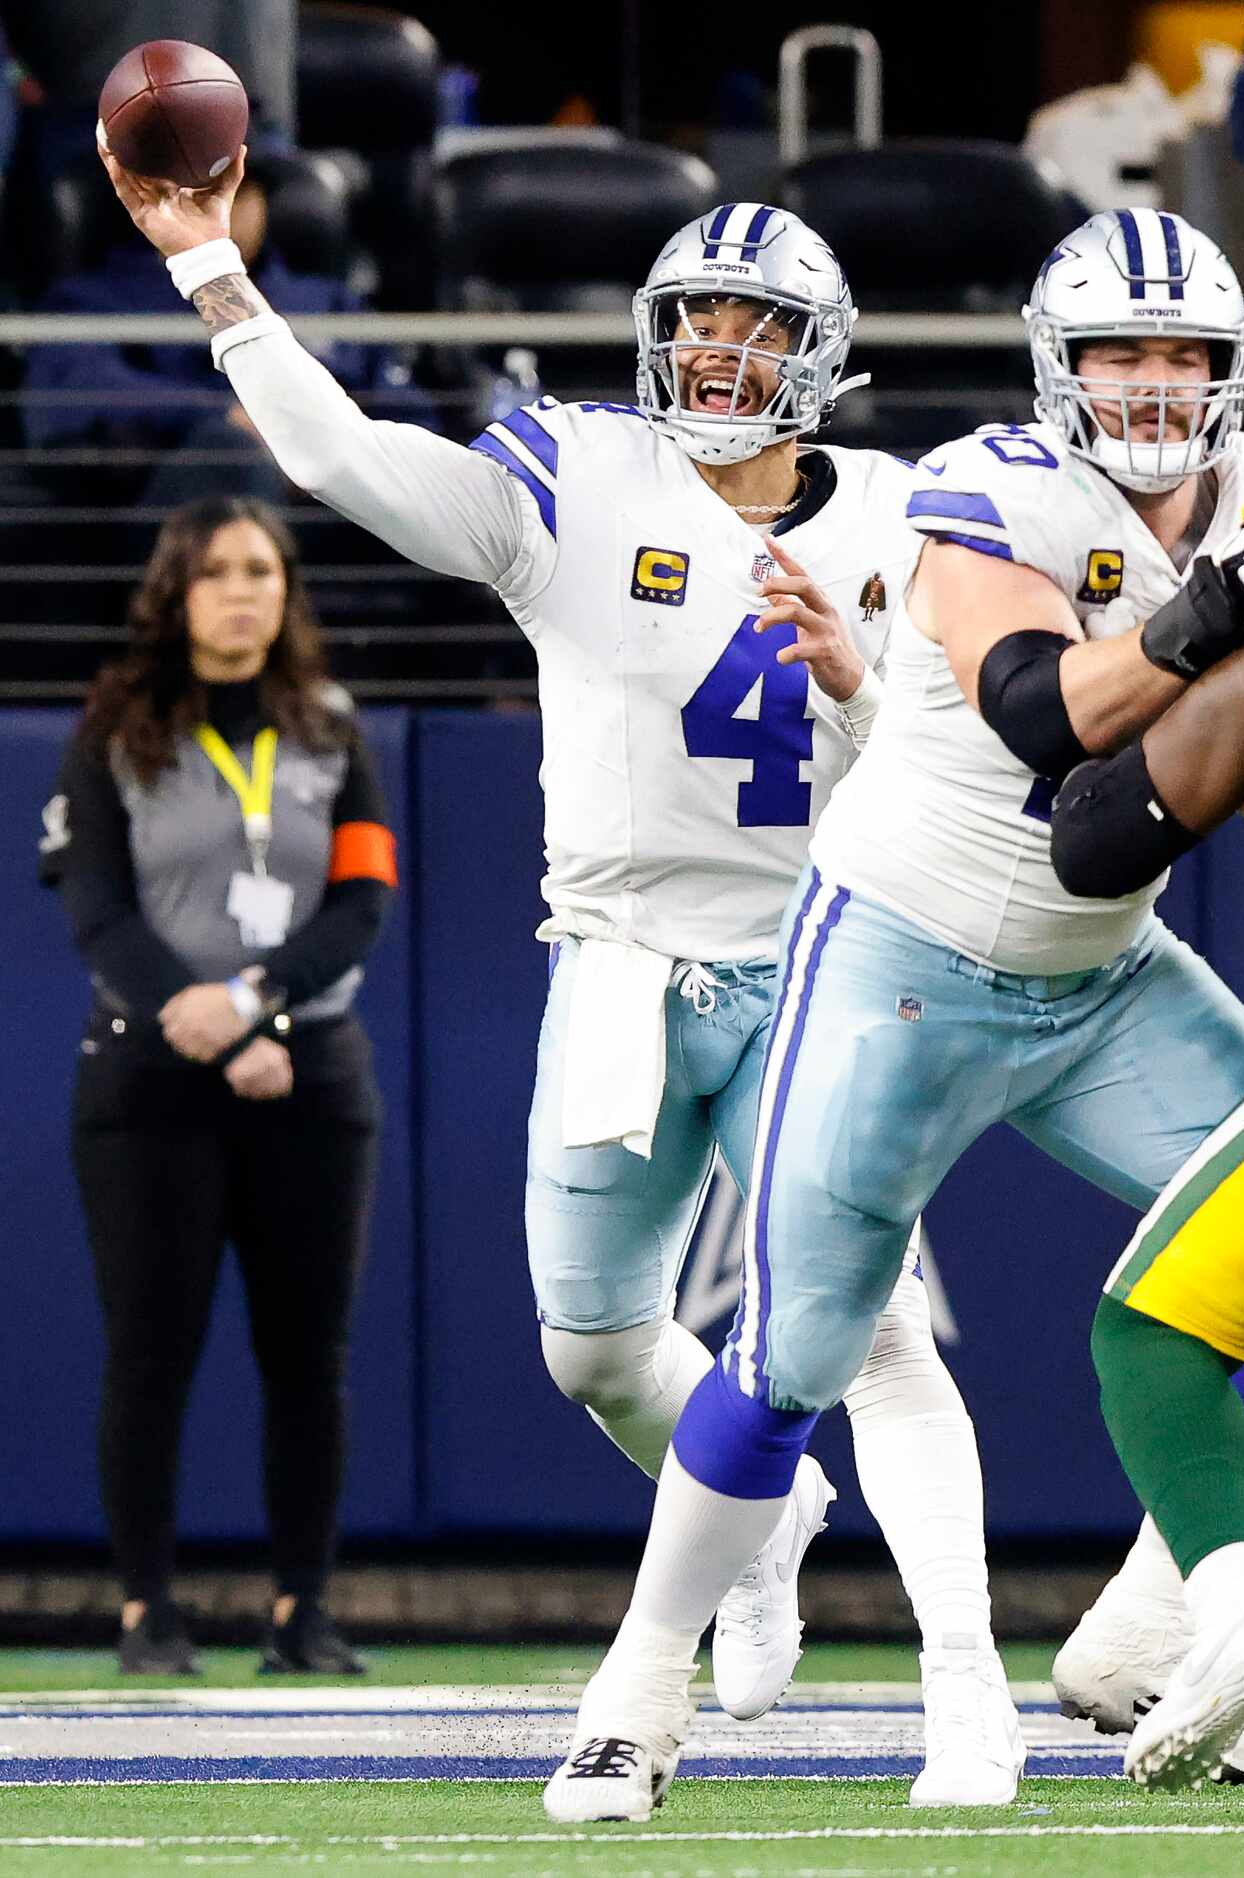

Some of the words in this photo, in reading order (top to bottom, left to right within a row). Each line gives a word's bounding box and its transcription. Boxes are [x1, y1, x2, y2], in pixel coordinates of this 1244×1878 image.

[702, 263, 751, 274] COWBOYS
[1132, 308, 1182, 317] COWBOYS
[636, 550, 687, 592] C
[1087, 551, 1122, 591] C
[680, 613, 816, 828] 4
